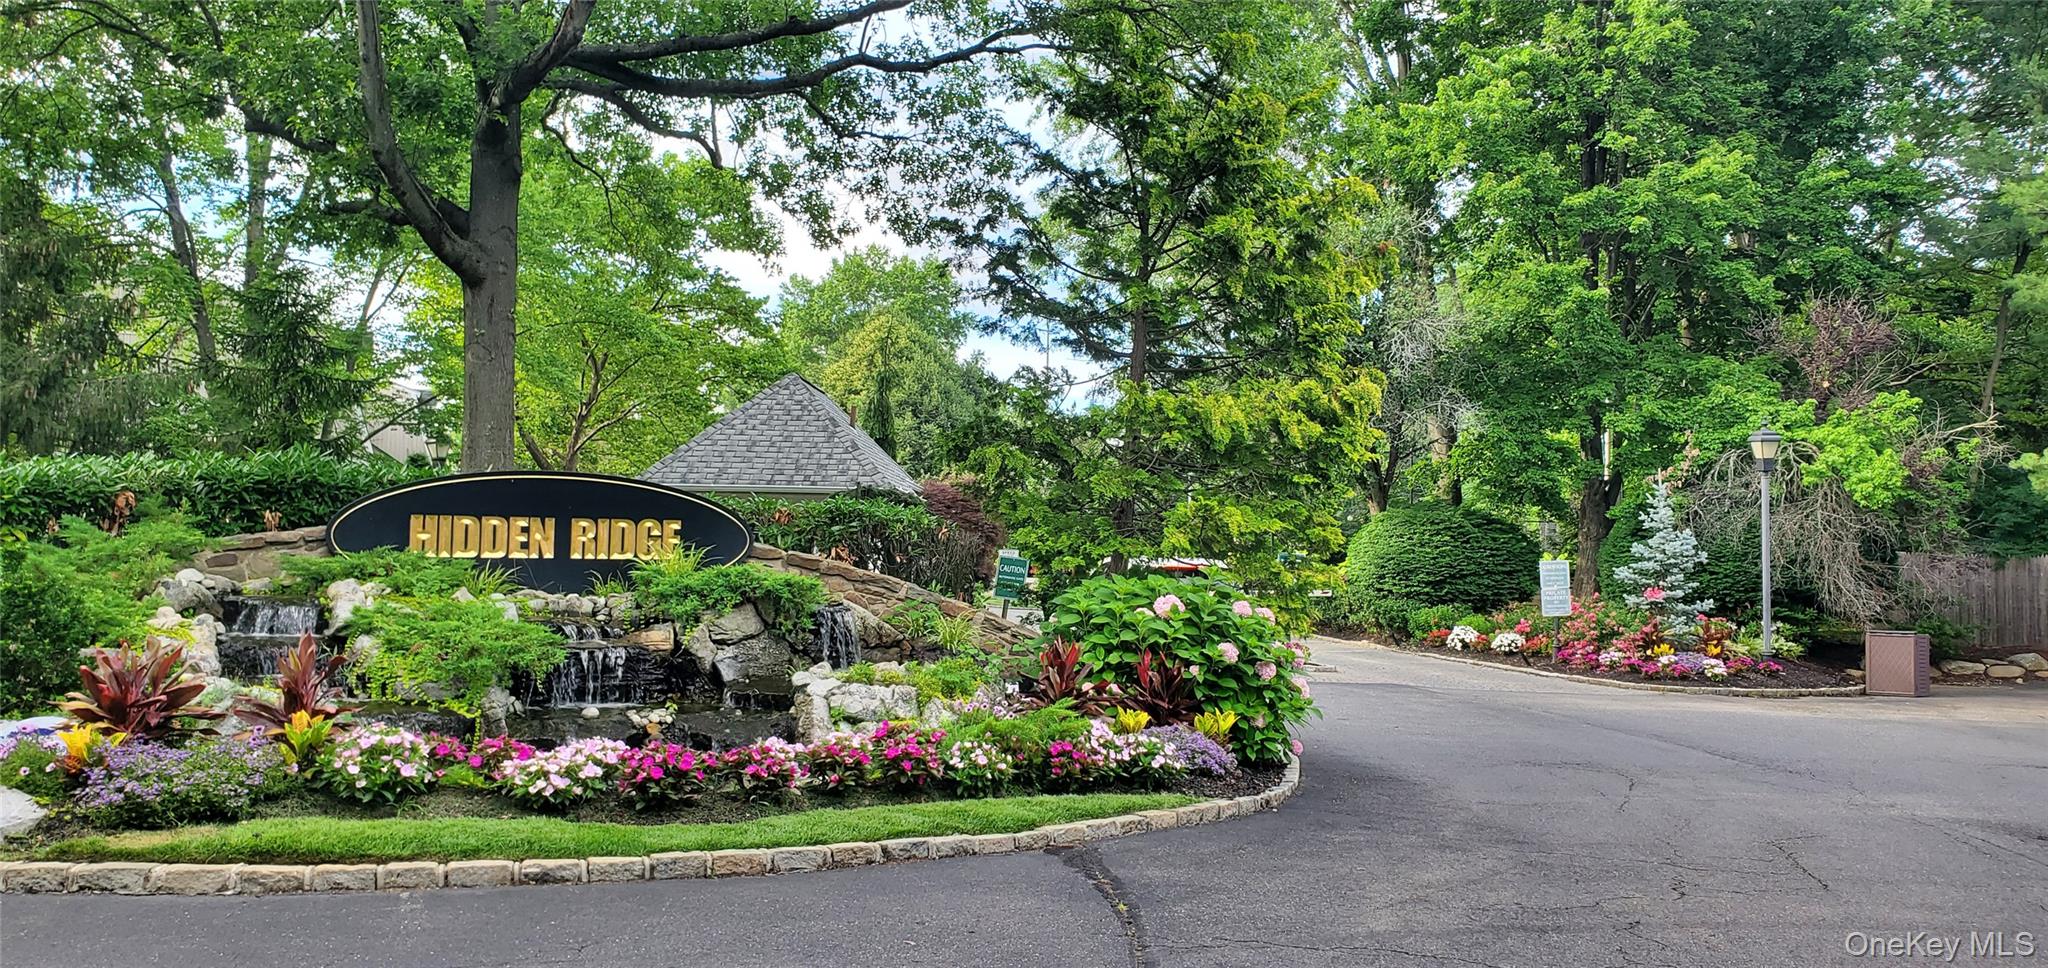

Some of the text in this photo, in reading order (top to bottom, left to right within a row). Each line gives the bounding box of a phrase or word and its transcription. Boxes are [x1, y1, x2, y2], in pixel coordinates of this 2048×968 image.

[409, 514, 681, 561] HIDDEN RIDGE
[1000, 564, 1026, 574] CAUTION
